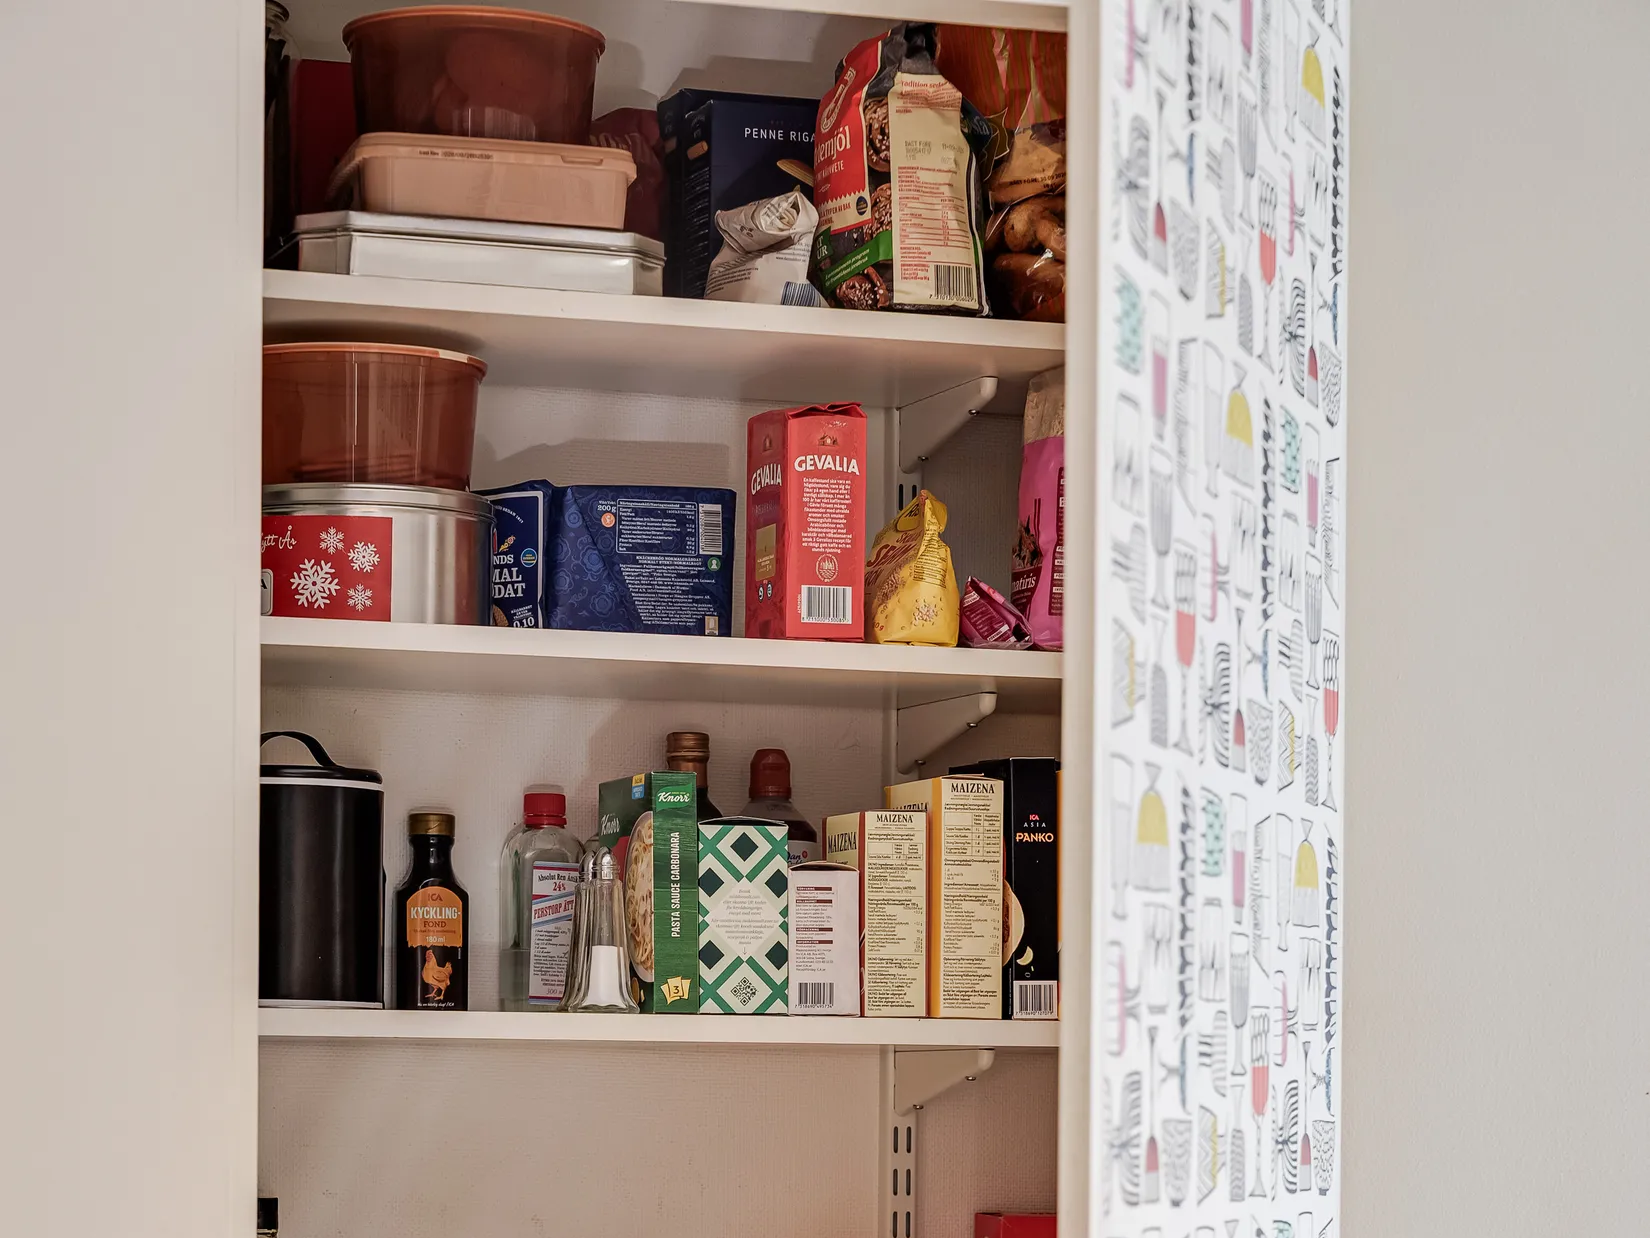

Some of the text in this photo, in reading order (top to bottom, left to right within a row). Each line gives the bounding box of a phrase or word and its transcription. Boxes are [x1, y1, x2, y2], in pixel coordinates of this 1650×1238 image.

[744, 128, 784, 140] PENNE
[794, 454, 860, 476] GEVALIA
[750, 463, 782, 496] GEVALIA
[278, 524, 298, 550] År
[492, 582, 526, 599] DAT
[950, 782, 995, 794] MAIZENA
[658, 792, 690, 803] Knorr
[601, 814, 620, 836] Knorr
[876, 814, 913, 823] MAIZENA
[828, 832, 857, 854] MAIZENA
[1016, 832, 1054, 842] PANKO
[670, 832, 681, 938] PASTA SAUCE CARBONARA
[428, 893, 443, 902] ICA
[410, 907, 461, 919] KYCKLING-
[534, 903, 562, 920] PERSTORP
[673, 985, 680, 994] 3
